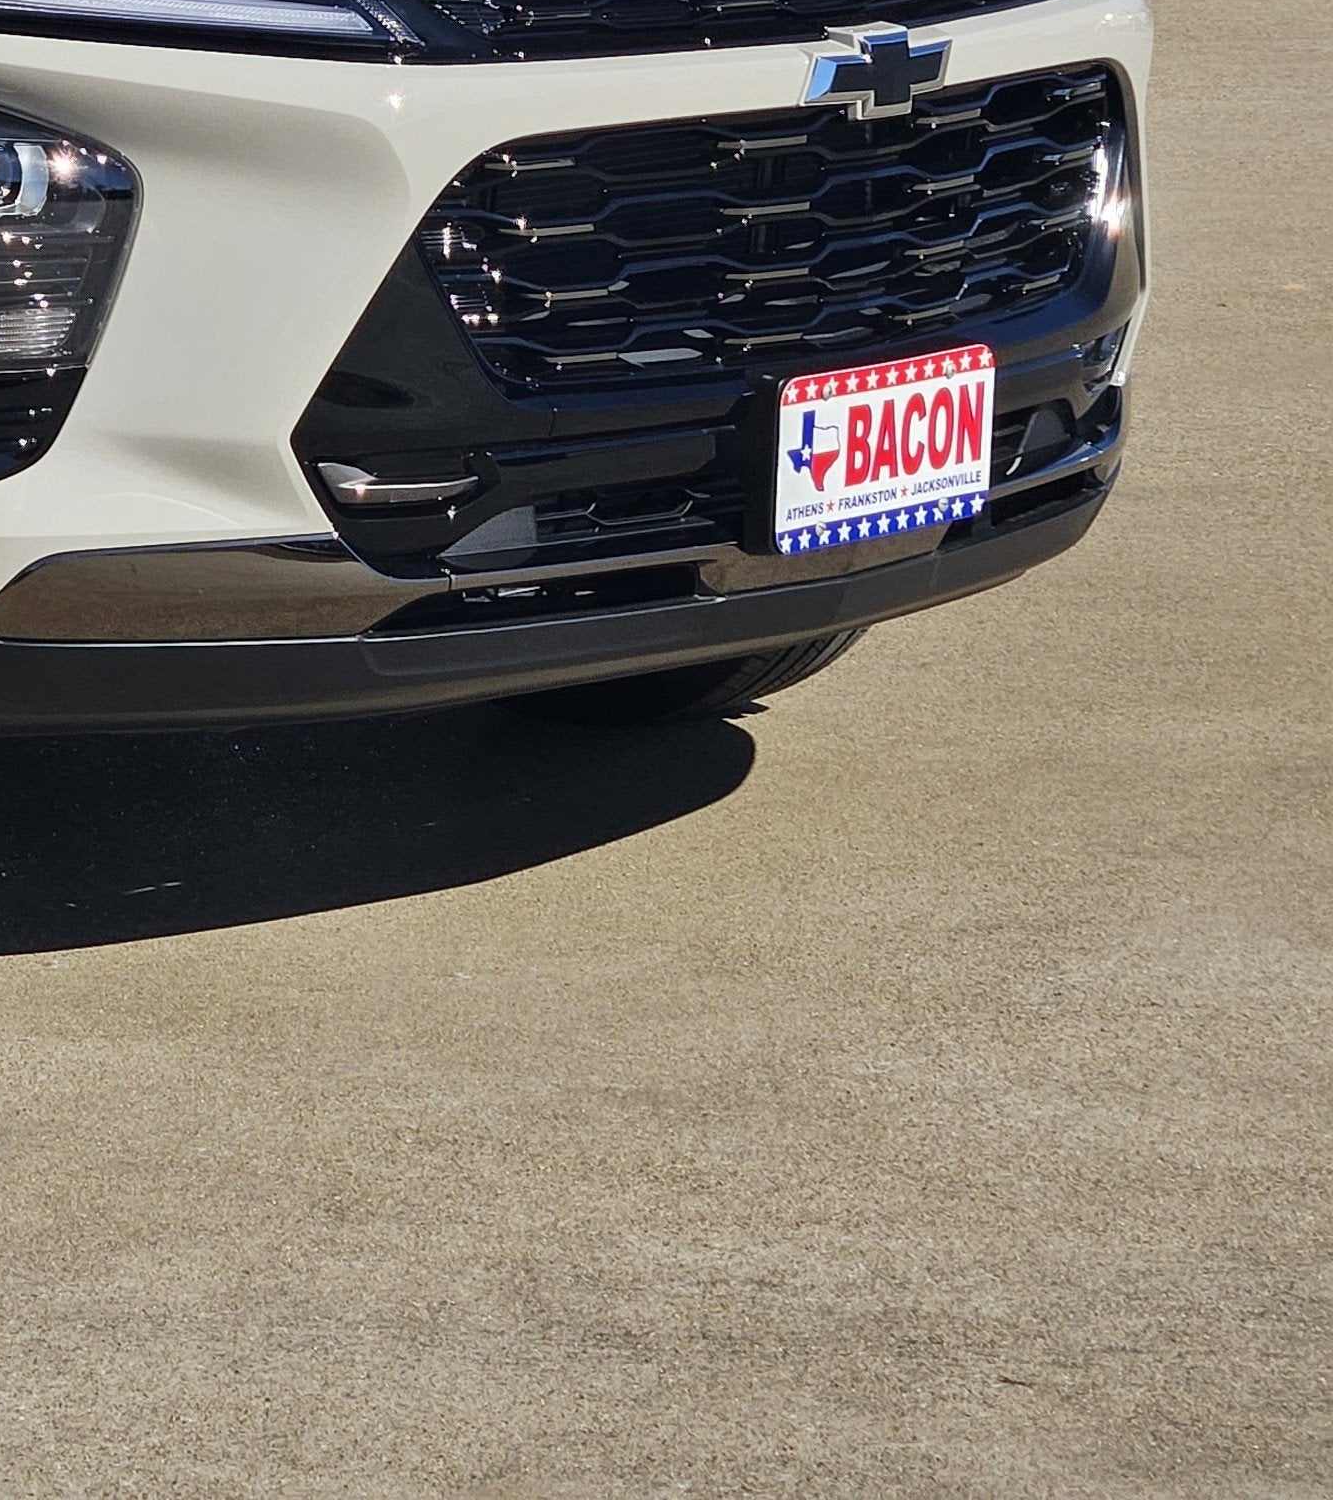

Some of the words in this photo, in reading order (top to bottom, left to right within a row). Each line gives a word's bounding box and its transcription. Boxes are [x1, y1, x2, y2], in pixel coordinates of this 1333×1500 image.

[845, 382, 985, 486] BACON
[786, 502, 824, 522] ATHENS
[838, 487, 897, 511] FRANKSTON
[911, 470, 982, 496] JACKSONVILLE
